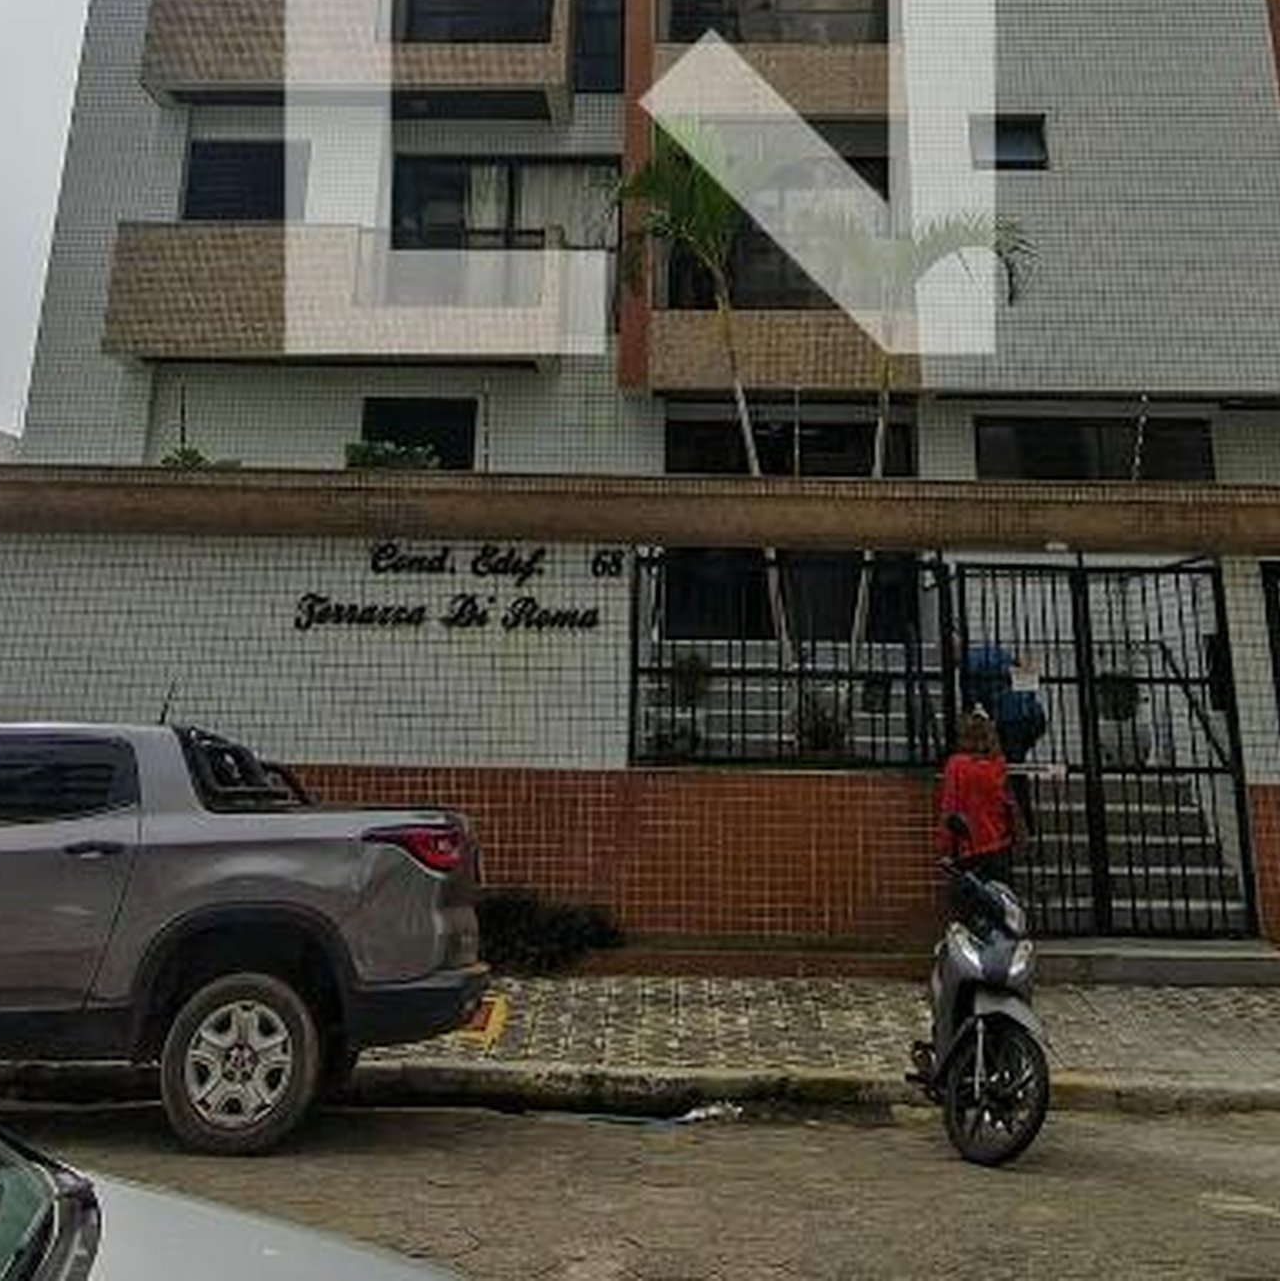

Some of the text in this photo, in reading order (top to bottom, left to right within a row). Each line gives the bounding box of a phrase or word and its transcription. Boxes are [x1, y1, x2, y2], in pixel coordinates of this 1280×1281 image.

[371, 543, 544, 587] Cond. Edif.
[442, 593, 496, 628] Di
[501, 597, 598, 631] Roma
